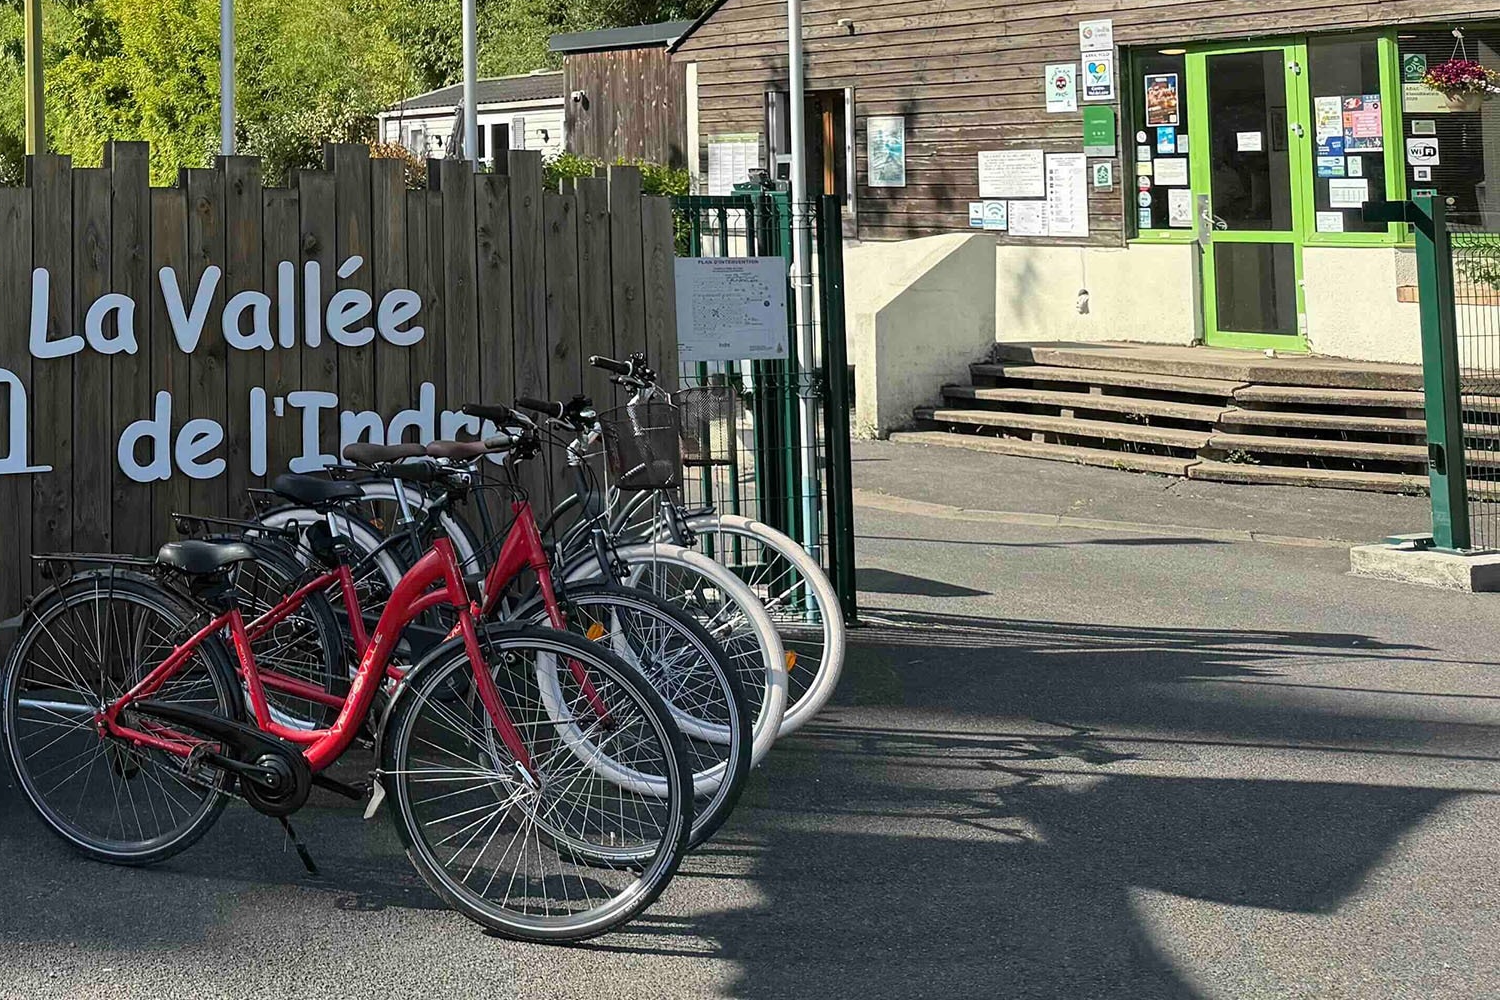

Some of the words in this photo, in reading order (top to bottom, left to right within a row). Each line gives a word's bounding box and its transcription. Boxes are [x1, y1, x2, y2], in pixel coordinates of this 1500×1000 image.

[28, 267, 139, 359] La
[158, 255, 426, 354] Vallée
[117, 390, 227, 483] de
